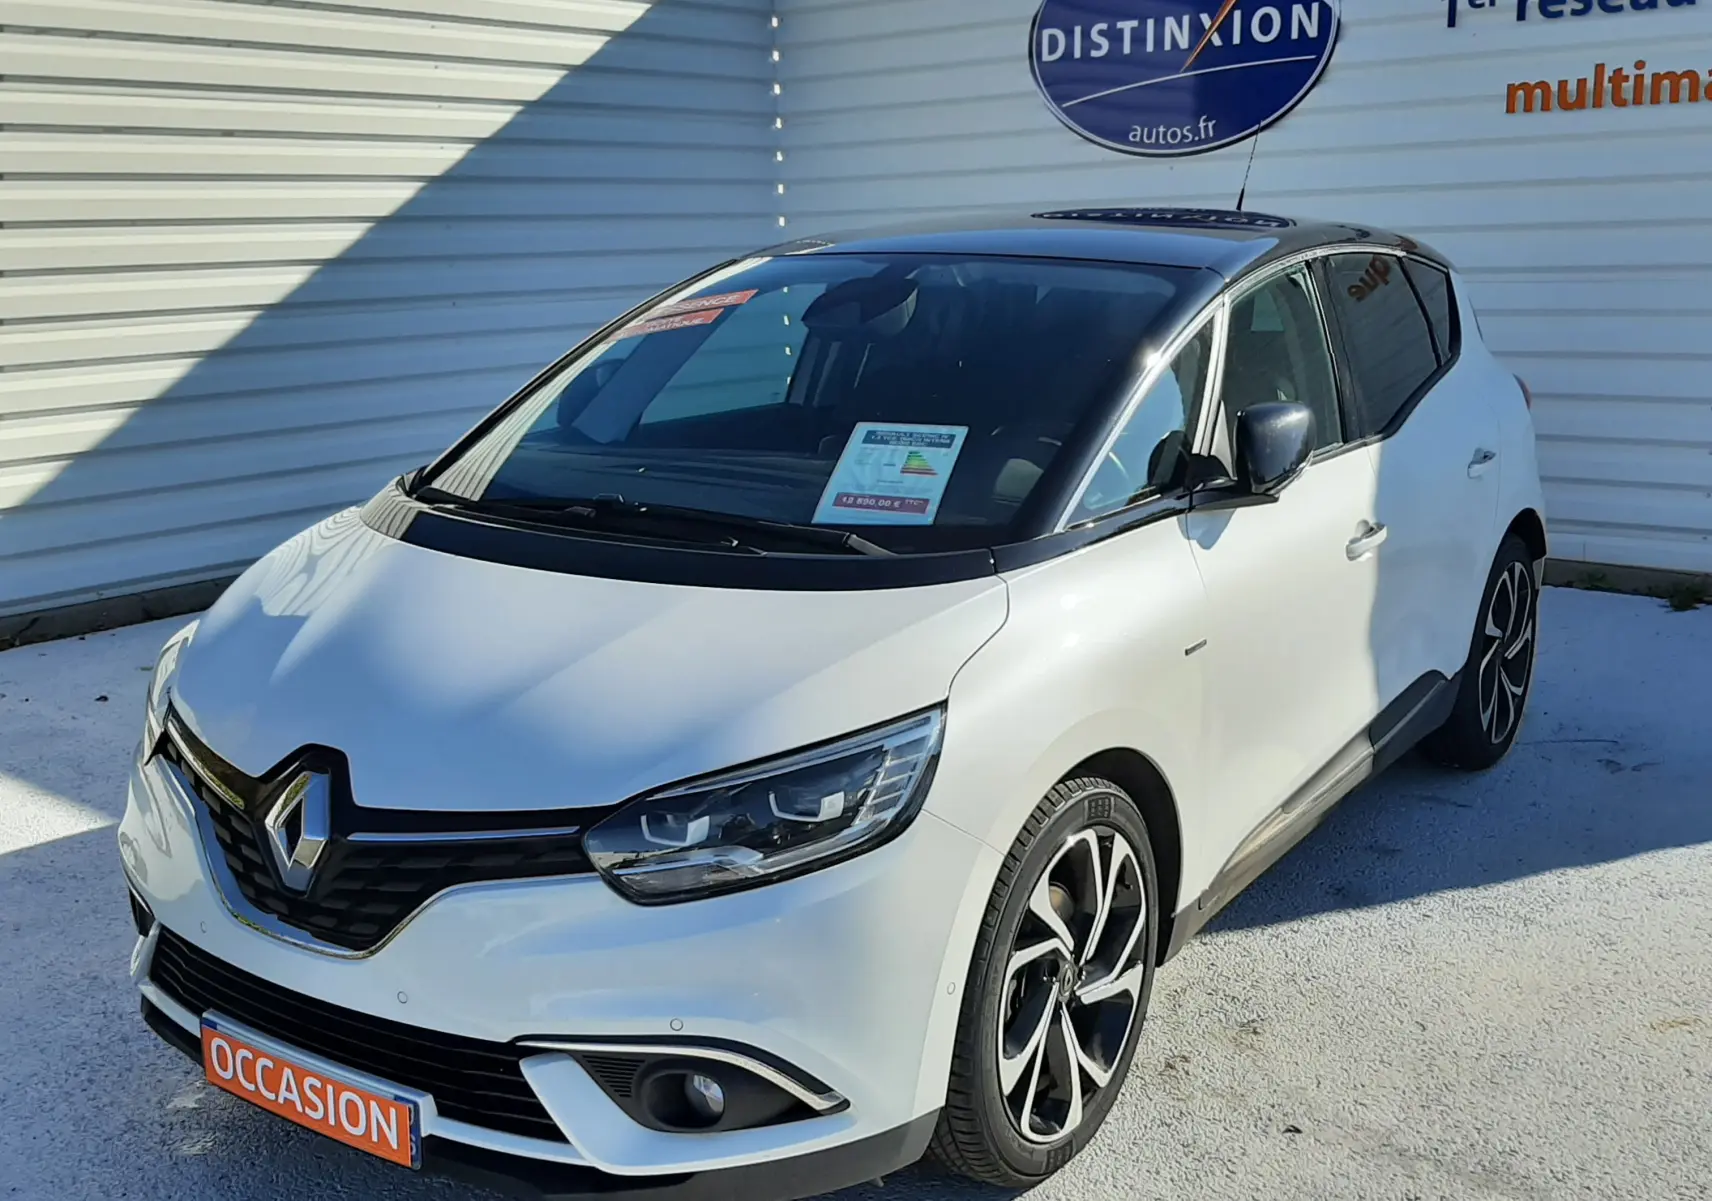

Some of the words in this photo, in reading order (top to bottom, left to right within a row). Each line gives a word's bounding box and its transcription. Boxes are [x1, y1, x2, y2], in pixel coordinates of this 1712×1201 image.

[1041, 2, 1319, 62] DISTINXION
[1129, 116, 1217, 145] autos.fr
[211, 1037, 398, 1150] OCCASION
